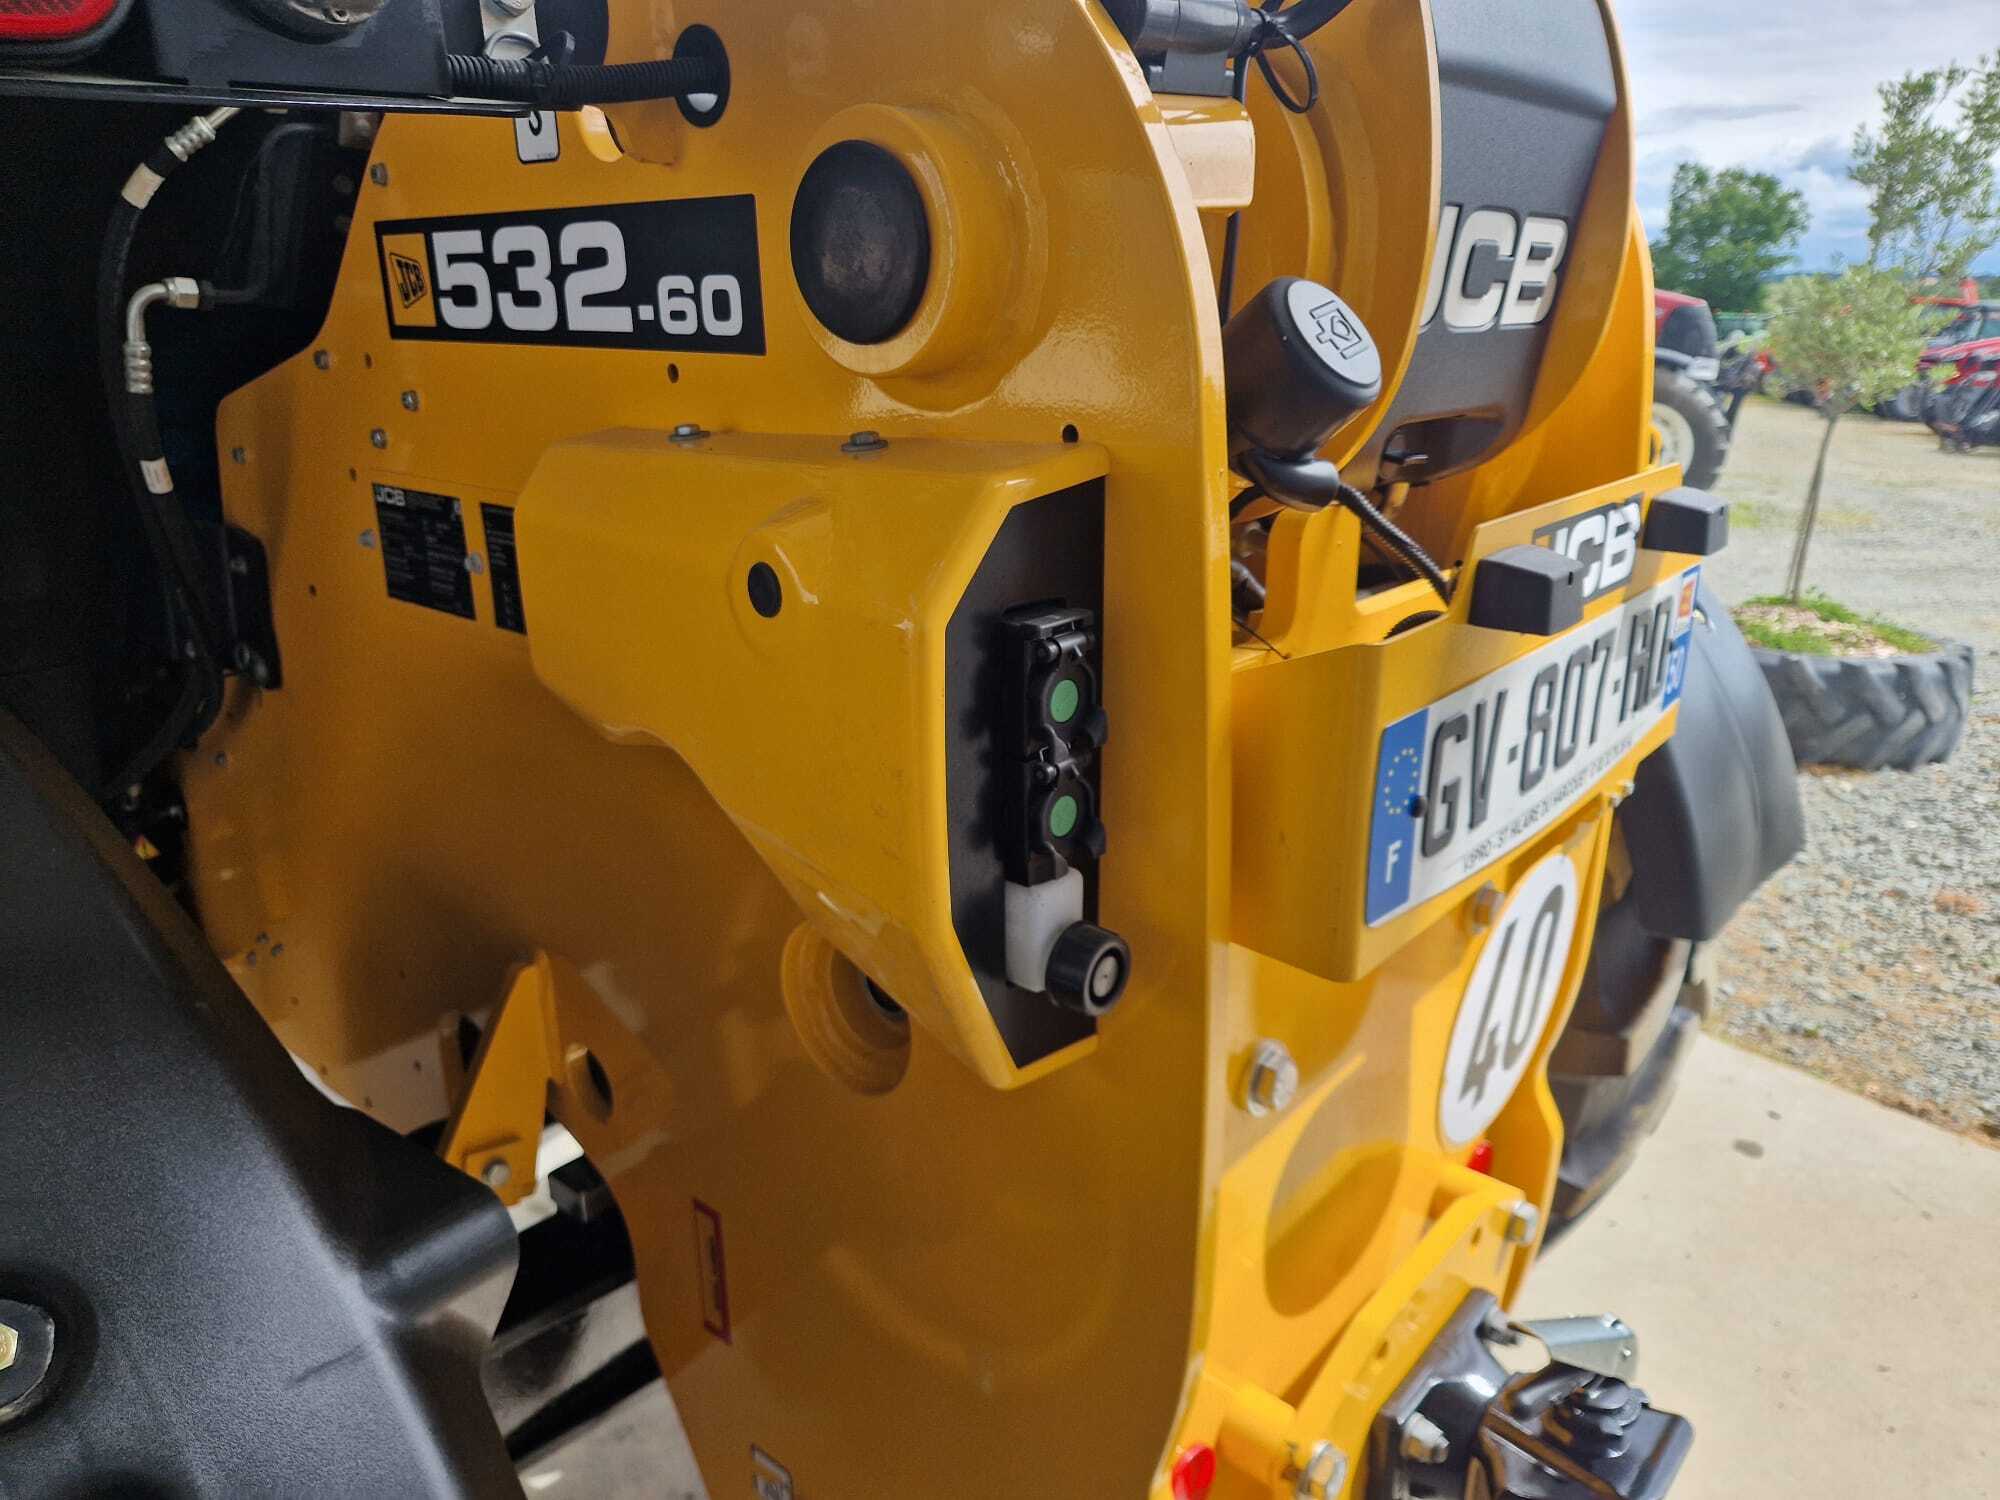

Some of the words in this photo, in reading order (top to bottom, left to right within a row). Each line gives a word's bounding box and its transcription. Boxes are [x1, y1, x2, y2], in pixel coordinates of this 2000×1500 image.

[395, 258, 425, 302] JCB
[1418, 205, 1568, 333] JCB
[1385, 840, 1402, 884] F
[1458, 884, 1564, 1110] 40
